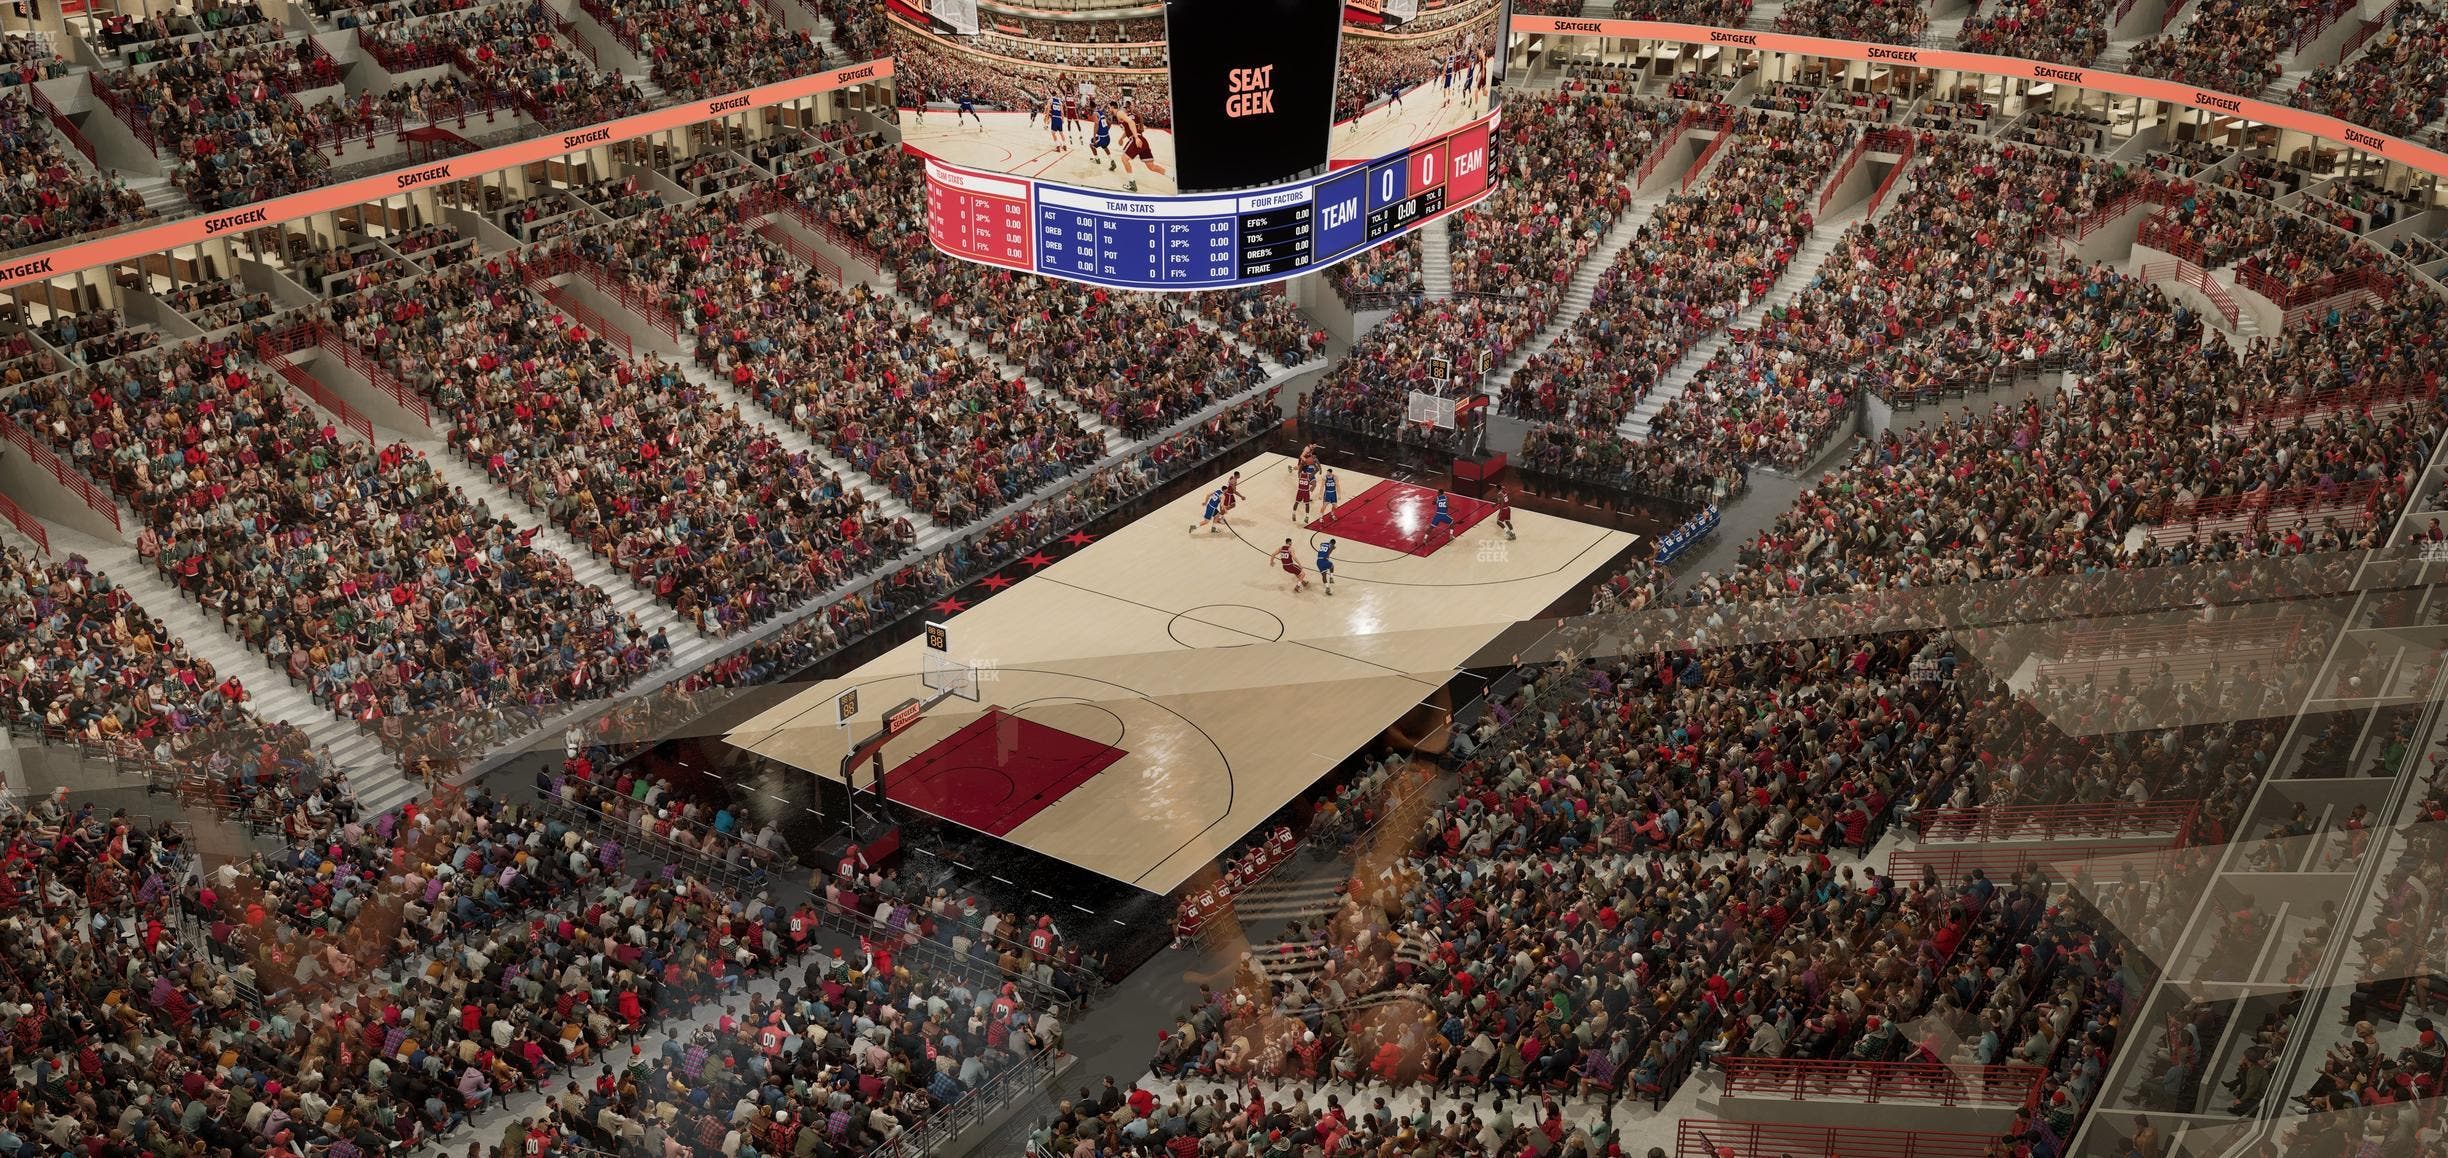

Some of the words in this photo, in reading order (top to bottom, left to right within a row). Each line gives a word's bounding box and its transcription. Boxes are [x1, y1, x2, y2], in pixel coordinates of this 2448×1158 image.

[1555, 21, 1601, 32] SEATGEEK
[1711, 32, 1757, 45] SEATGEEK
[1868, 48, 1917, 62] SEATGEEK
[838, 66, 874, 83] SEATGEEK
[1229, 64, 1273, 92] SEAT
[2034, 66, 2082, 83] SEATGEEK
[710, 95, 750, 114] SEATGEEK
[1226, 90, 1274, 118] GEEK
[2196, 93, 2241, 113] SEATGEEK
[564, 128, 610, 148] SEATGEEK
[2345, 129, 2385, 151] SEATGEEK
[1423, 154, 1433, 185] 0
[1455, 148, 1482, 178] TEAM
[398, 165, 450, 188] SEATGEEK
[1382, 169, 1393, 202] 0
[1252, 198, 1272, 208] FOUR
[1274, 192, 1303, 204] FACTORS
[1107, 202, 1128, 212] TEAM
[1130, 204, 1154, 213] STATS
[1322, 197, 1357, 231] TEAM
[1398, 199, 1416, 220] 0:00
[205, 208, 267, 234] SEATGEEK
[1045, 212, 1056, 220] AST
[1077, 217, 1092, 228] 0.00
[1296, 209, 1310, 220] 0.00
[1104, 221, 1116, 230] BLK
[1150, 225, 1155, 233] 0
[1171, 225, 1189, 233] 2P%
[1210, 222, 1229, 232] 0.00
[1296, 225, 1309, 236] 0.00
[1077, 232, 1092, 242] 0.00
[1171, 240, 1189, 248] 3P%
[1210, 237, 1229, 247] 0.00
[1150, 240, 1155, 248] 0
[1296, 240, 1309, 251] 0.00
[1007, 248, 1022, 258] 0.00
[1078, 247, 1093, 257] 0.00
[1104, 251, 1117, 260] POT
[1150, 255, 1155, 263] 0
[1171, 254, 1189, 263] FG%
[1210, 252, 1229, 262] 0.00
[1046, 256, 1056, 264] STL
[1078, 261, 1093, 272] 0.00
[1247, 264, 1270, 274] FTRATE
[1295, 256, 1309, 266] 0.00
[1104, 266, 1116, 274] STL
[1150, 270, 1155, 278] 0
[1210, 267, 1229, 277] 0.00
[1280, 831, 1292, 842] 00
[1256, 856, 1266, 865] 00
[1218, 886, 1230, 897] 00
[1200, 895, 1214, 907] 00
[790, 918, 800, 931] 00
[1034, 936, 1045, 949] 00
[764, 1033, 775, 1047] 00
[526, 1139, 538, 1154] 00
